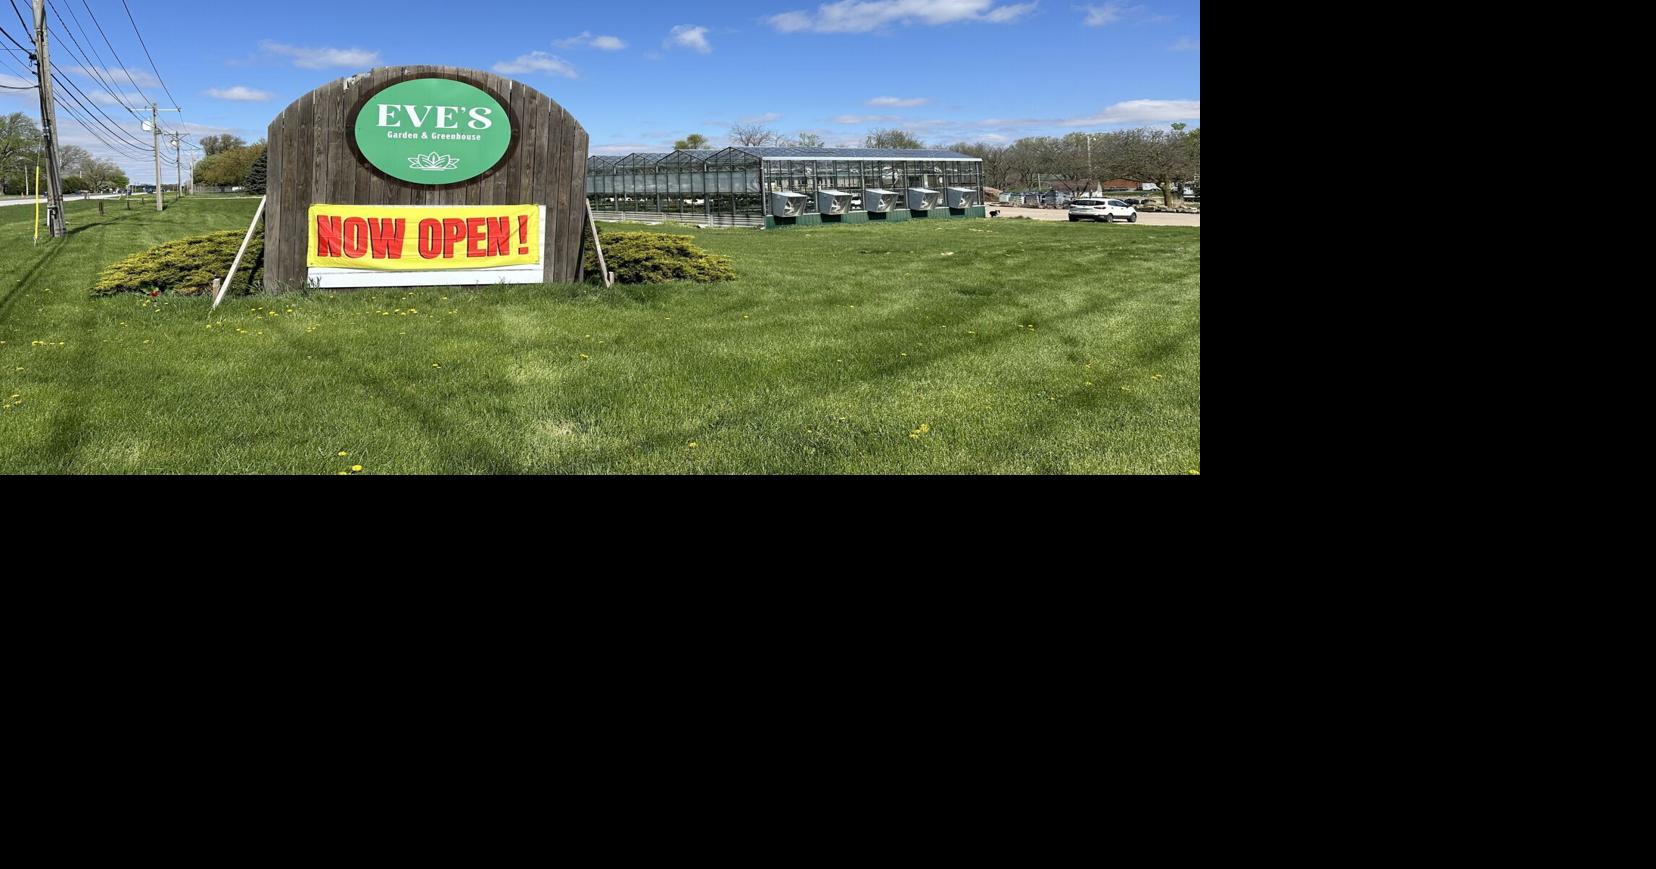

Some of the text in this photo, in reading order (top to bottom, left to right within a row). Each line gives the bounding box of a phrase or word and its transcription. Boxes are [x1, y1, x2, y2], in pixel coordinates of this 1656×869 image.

[376, 103, 493, 130] EVE'S
[387, 130, 481, 141] Garden & Greenhouse
[316, 214, 406, 259] NOW
